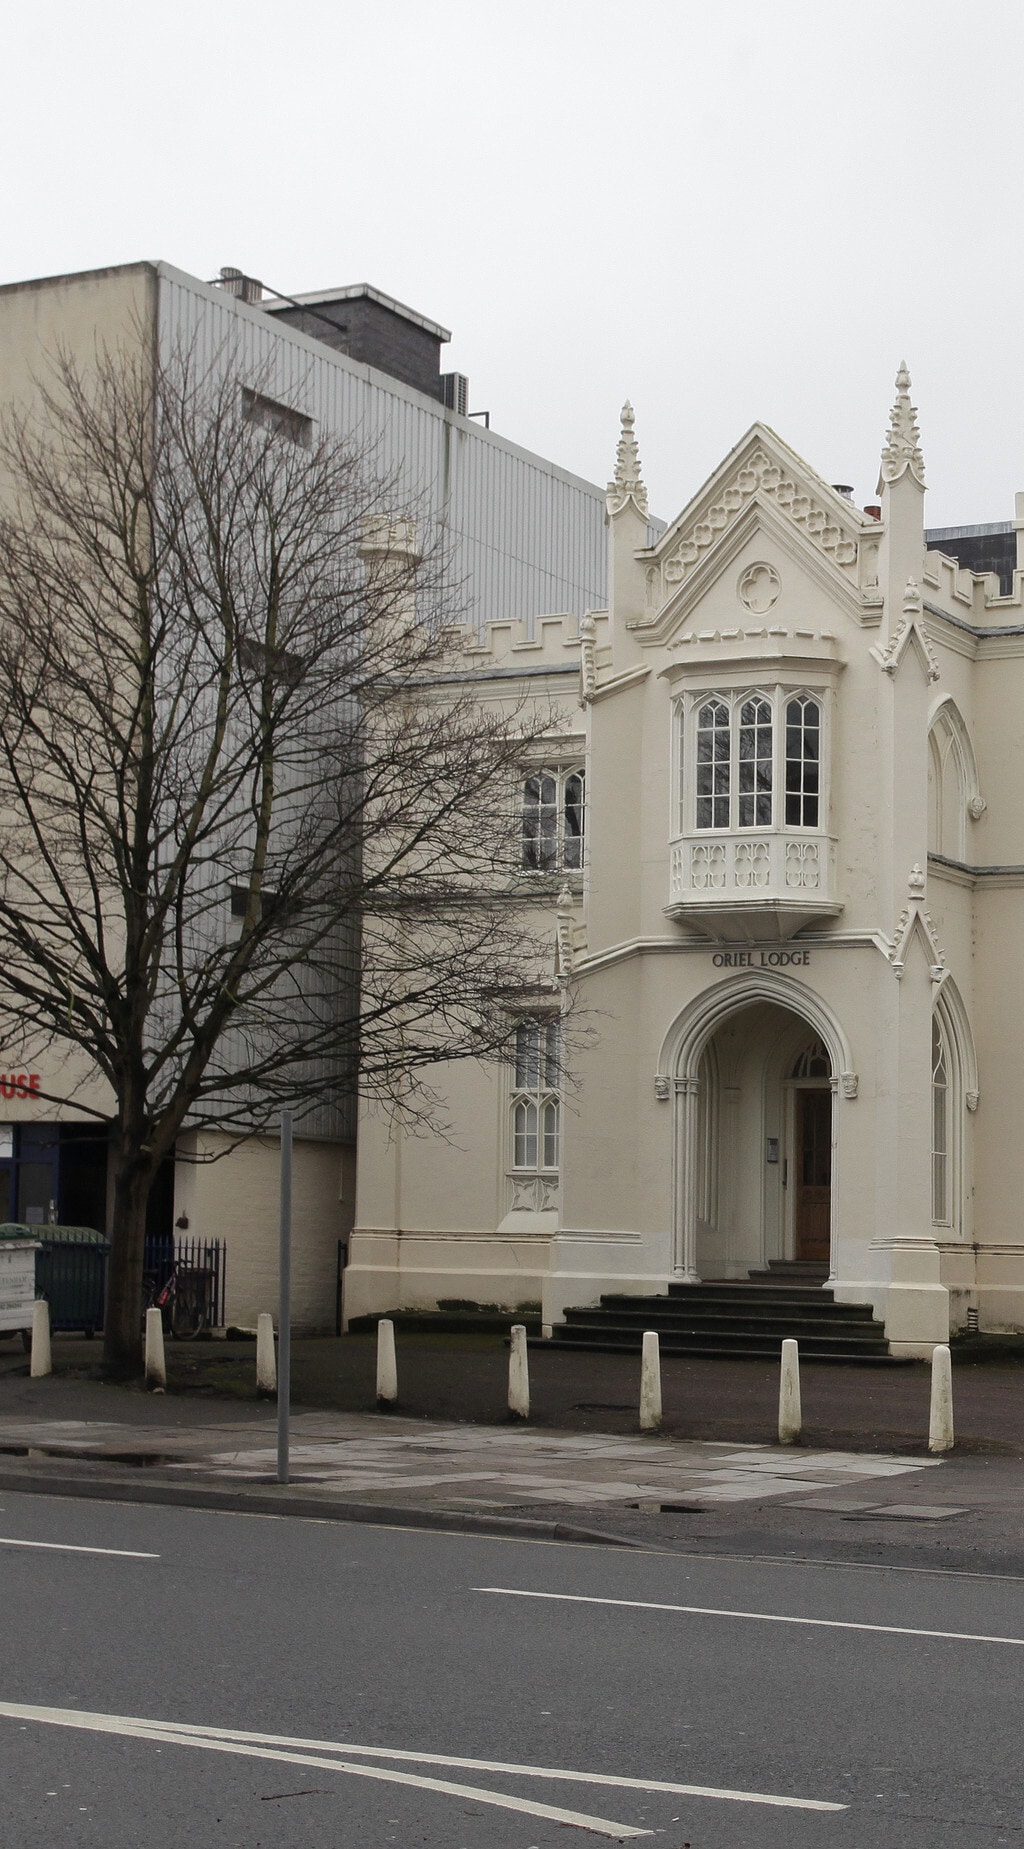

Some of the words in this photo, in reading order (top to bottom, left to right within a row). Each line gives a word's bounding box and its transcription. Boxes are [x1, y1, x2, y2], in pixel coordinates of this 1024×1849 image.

[712, 953, 754, 967] ORIEL
[760, 951, 811, 966] LODGE
[0, 1074, 41, 1099] USE
